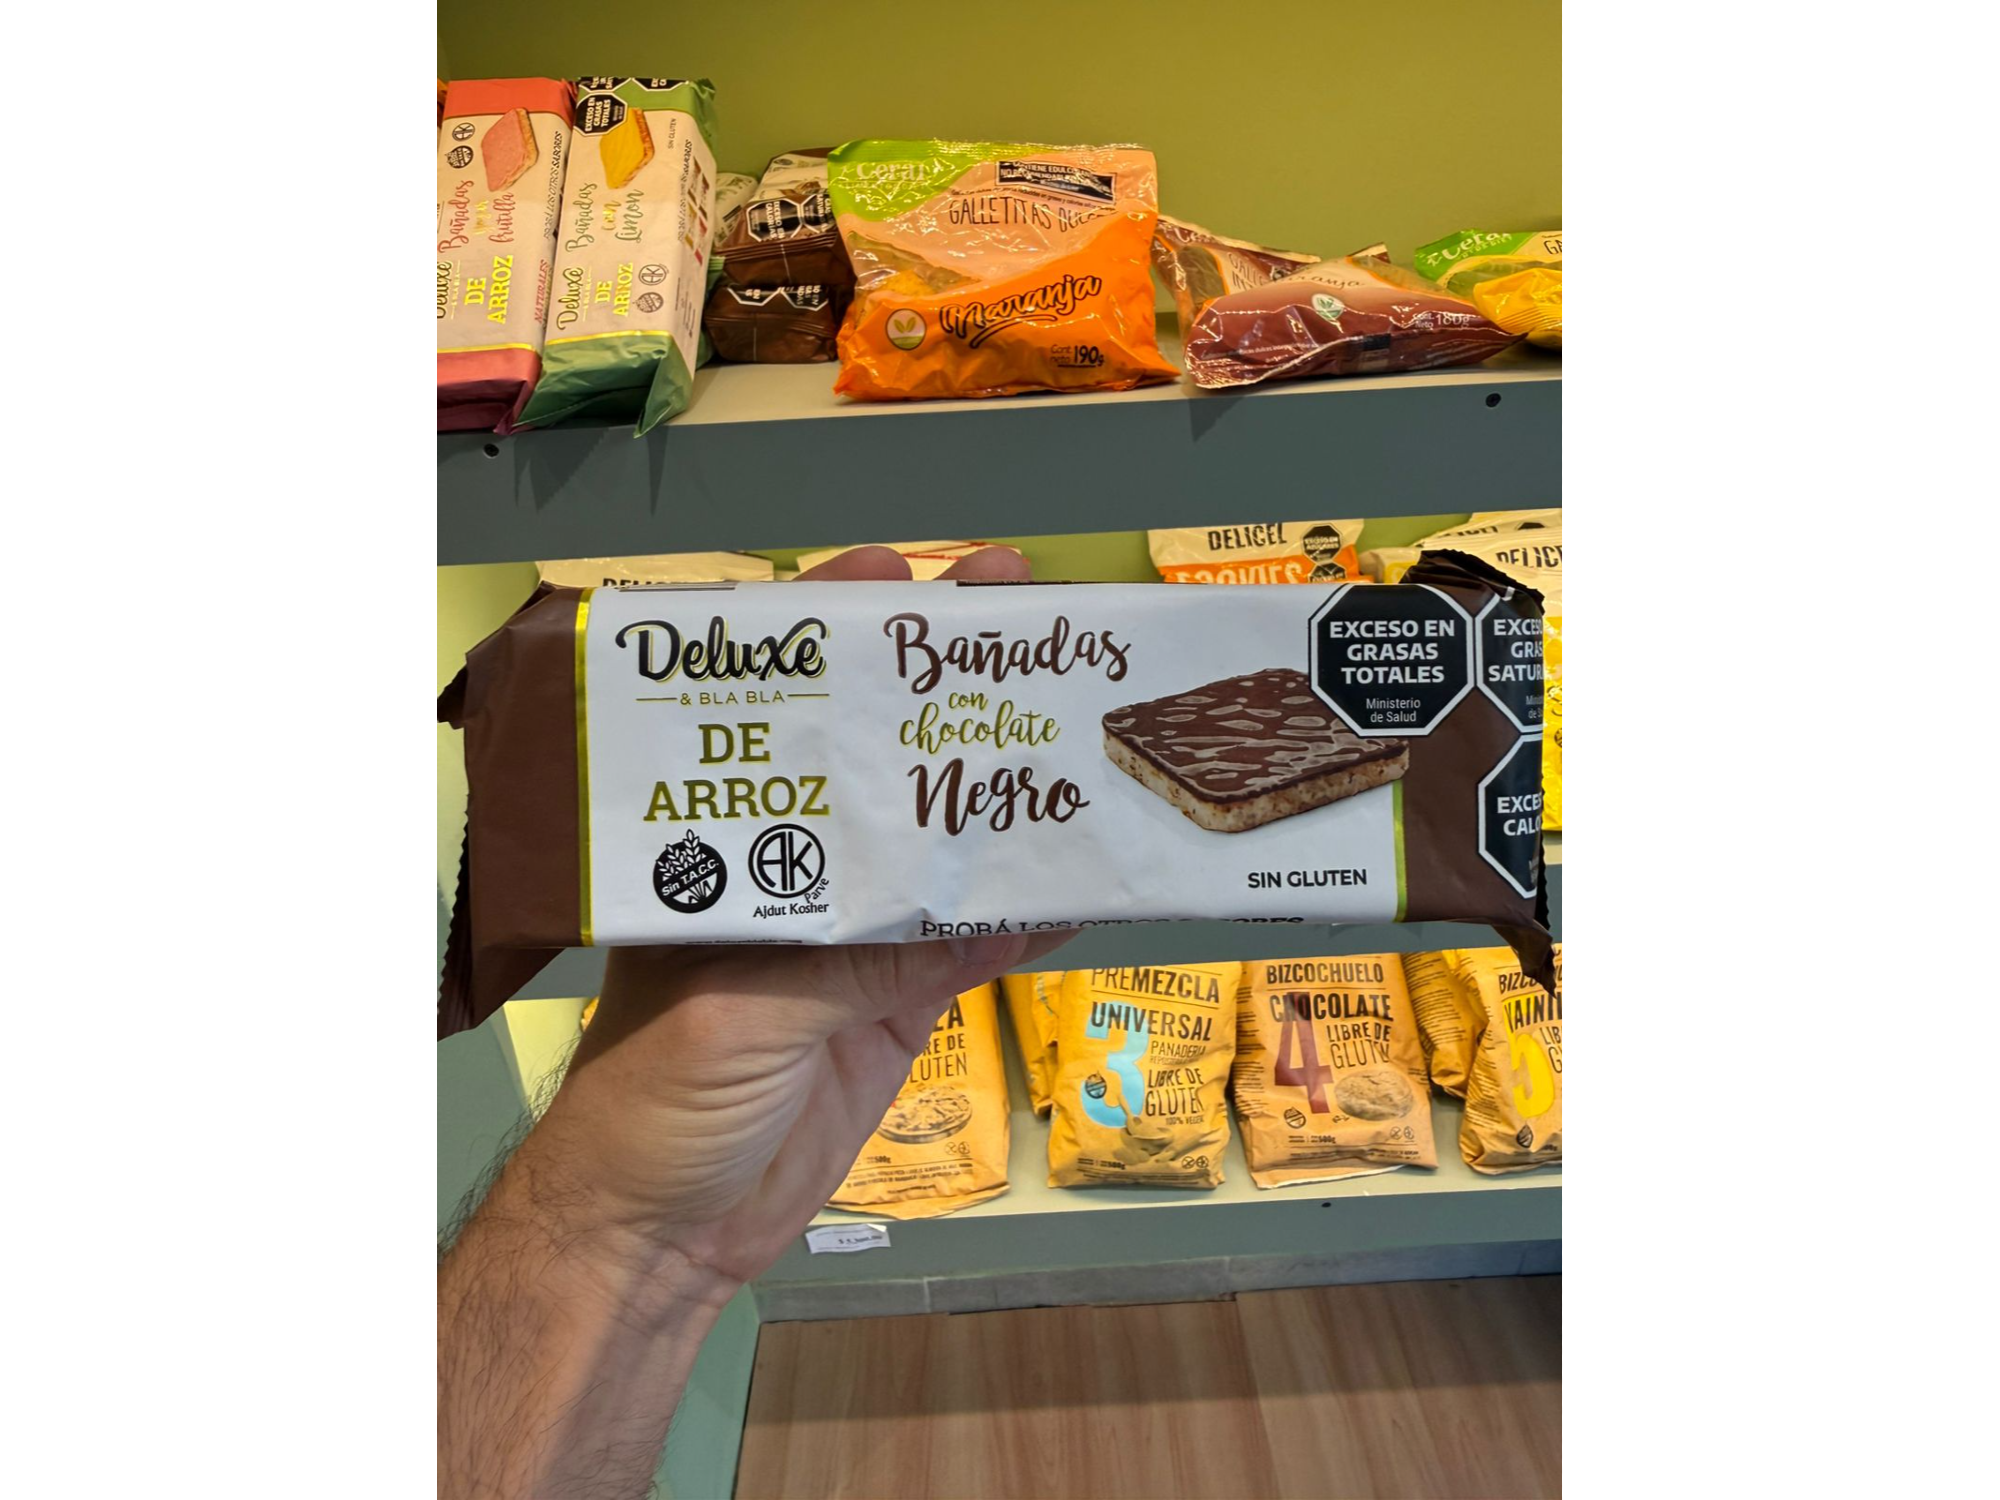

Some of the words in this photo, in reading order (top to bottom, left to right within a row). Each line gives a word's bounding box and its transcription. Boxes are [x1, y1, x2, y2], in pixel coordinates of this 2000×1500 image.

[587, 97, 596, 108] EN
[593, 101, 603, 126] GRASAS
[601, 99, 611, 127] TOTALES
[585, 109, 595, 132] EXCESO
[438, 180, 475, 253] Bañadas
[565, 182, 598, 252] Bañadas
[949, 197, 1052, 230] GALLETITAS
[464, 277, 487, 306] DE
[487, 254, 514, 325] ARROZ
[556, 267, 584, 331] Deluxe
[594, 280, 613, 303] DE
[612, 262, 634, 317] ARROZ
[939, 274, 1102, 340] Naranja
[1074, 345, 1104, 367] 190g
[1207, 523, 1287, 551] DELICEL
[1496, 545, 1563, 569] DELIC
[1329, 620, 1419, 639] EXCESO
[1424, 619, 1455, 638] EN
[614, 615, 830, 682] Deluxe
[883, 612, 1132, 694] Bañadas
[1346, 643, 1439, 662] GRASAS
[1510, 641, 1543, 659] GRAS
[1341, 666, 1445, 685] TOTALES
[1488, 664, 1543, 682] SATUR
[680, 693, 692, 705] &
[700, 691, 738, 704] BLA
[746, 690, 785, 703] BLA
[948, 691, 989, 711] con
[1365, 698, 1421, 710] Ministerio
[899, 699, 1060, 754] chocolate
[1370, 711, 1384, 723] de
[1386, 710, 1417, 723] Salud
[698, 722, 771, 764] DE
[643, 775, 830, 821] ARROZ
[907, 757, 1091, 836] Negro
[1497, 792, 1541, 814] EXCE
[1503, 815, 1541, 836] CALO
[661, 881, 680, 897] Sin
[803, 876, 829, 903] Parve
[1247, 870, 1282, 889] SIN
[1286, 868, 1368, 888] GLUTEN
[753, 905, 787, 919] Ajdut
[789, 902, 829, 916] Kosher
[920, 918, 1011, 938] PROBÁ
[1266, 962, 1384, 984] BIZCOCHUELO
[1090, 967, 1220, 1004] PREMEZCLA
[1269, 992, 1394, 1023] CHOCOLATE
[1090, 1001, 1213, 1042] UNIVERSAL
[1326, 1022, 1371, 1043] LIBRE
[1374, 1023, 1391, 1042] DE
[947, 1033, 966, 1050] DE
[1539, 1026, 1563, 1046] LIB
[1274, 991, 1334, 1114] 4
[910, 1052, 968, 1083] LUTEN
[1080, 1001, 1150, 1129] 3
[1148, 1067, 1184, 1089] LIBRE
[1185, 1068, 1204, 1085] DE
